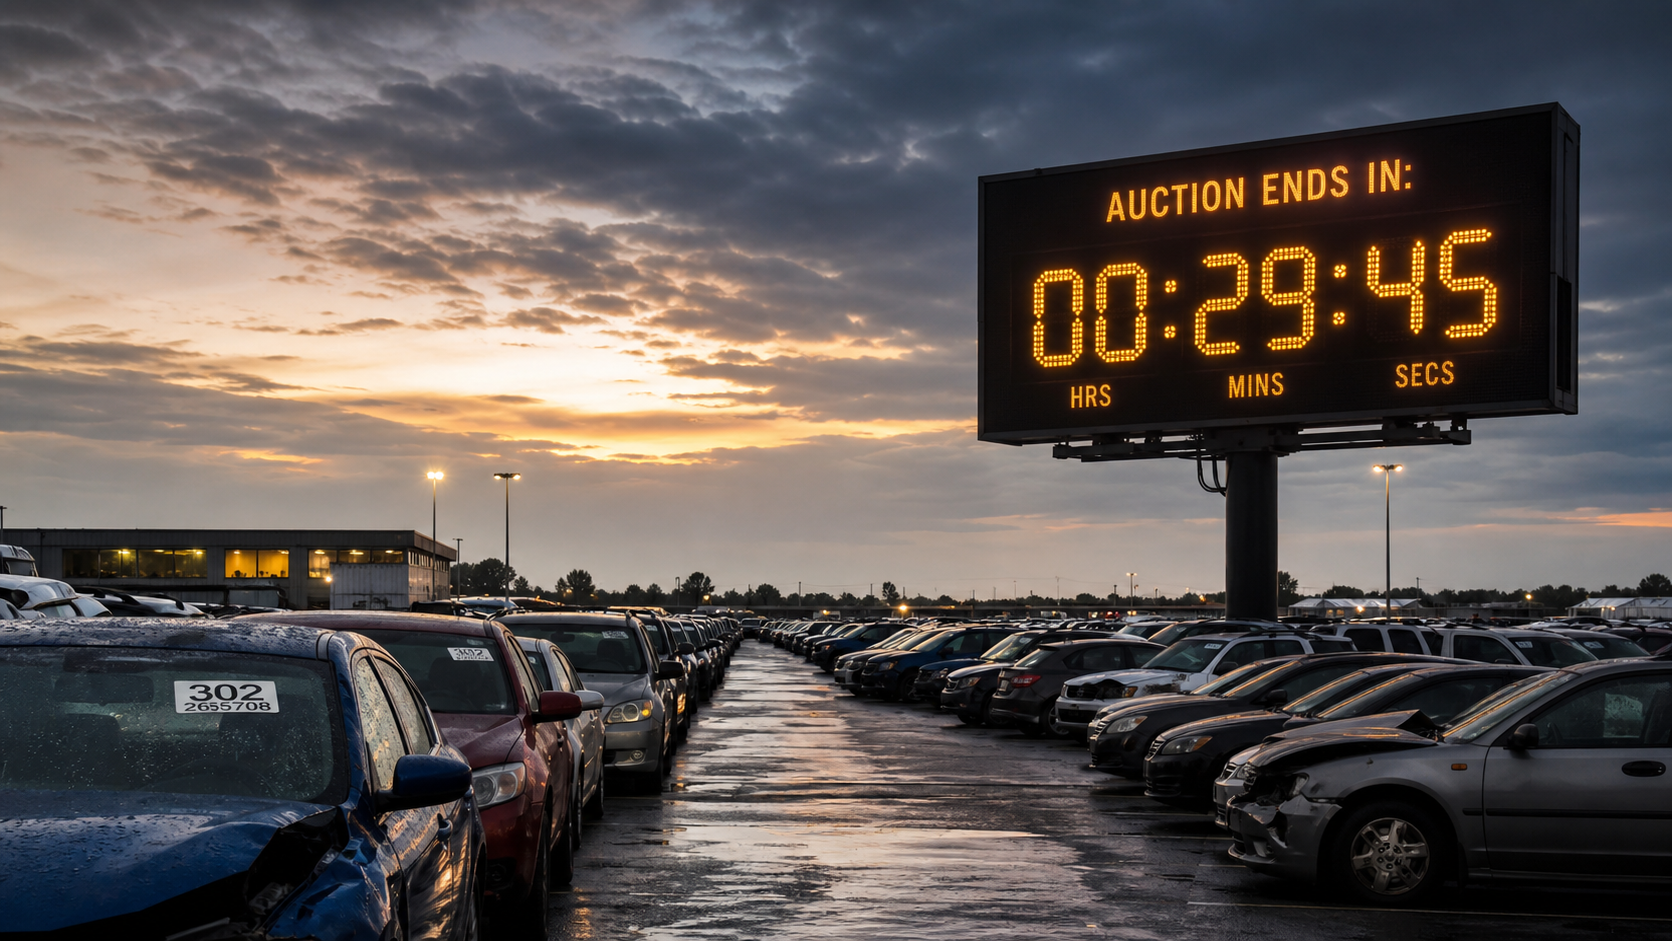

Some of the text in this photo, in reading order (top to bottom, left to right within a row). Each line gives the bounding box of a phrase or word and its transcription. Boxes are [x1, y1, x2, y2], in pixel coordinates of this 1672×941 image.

[1106, 159, 1412, 222] AUCTION ENDS IN:
[1033, 228, 1498, 368] 00:29:45
[1228, 372, 1284, 398] MINS
[1395, 361, 1455, 388] SECS
[1070, 384, 1111, 408] HRS
[189, 684, 264, 701] 302
[184, 702, 271, 711] 2655708
